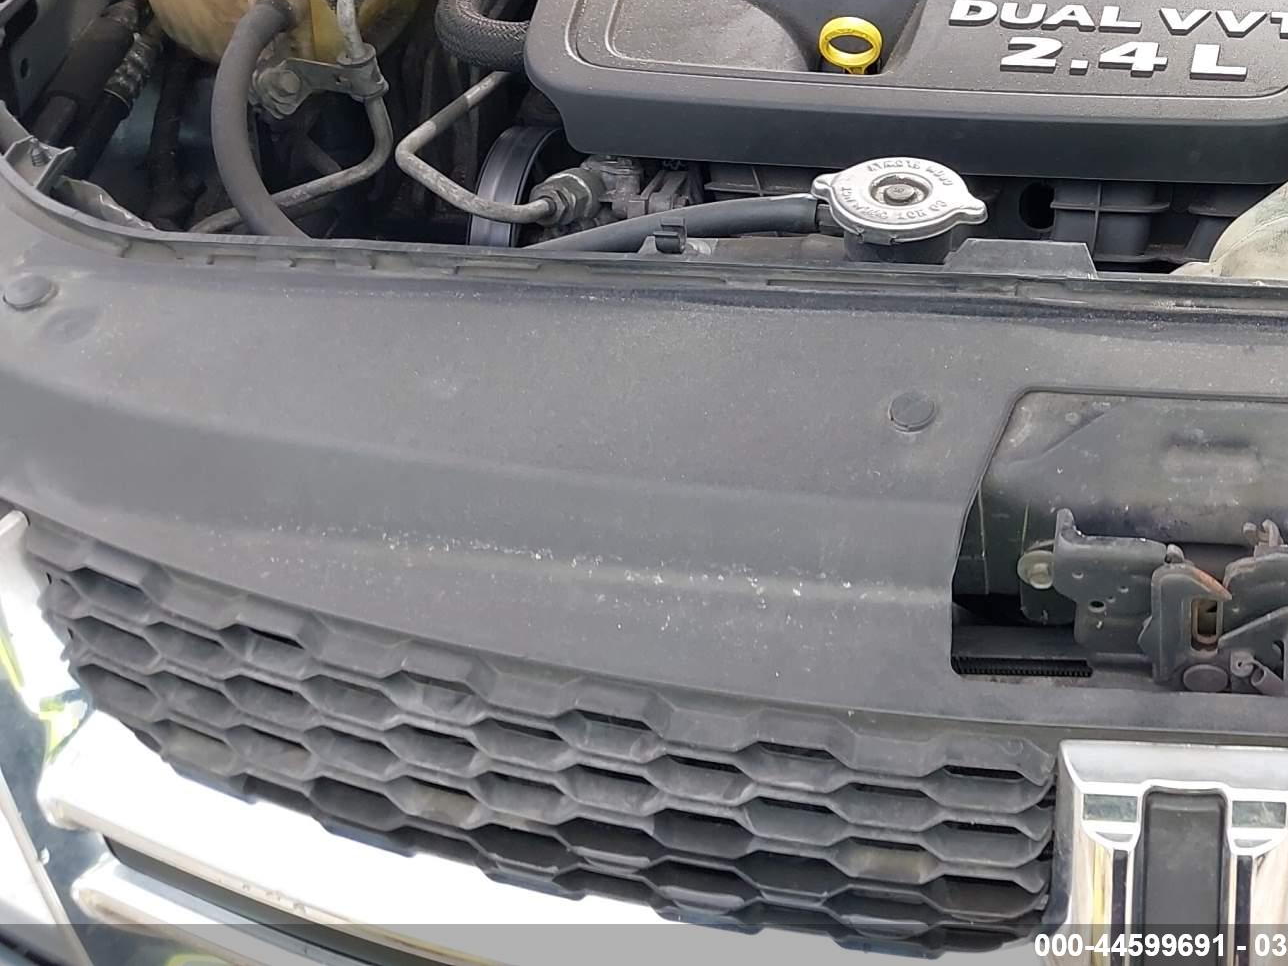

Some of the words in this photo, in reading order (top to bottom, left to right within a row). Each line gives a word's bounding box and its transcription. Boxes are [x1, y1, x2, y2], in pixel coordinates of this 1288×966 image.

[949, 0, 1142, 33] DUAL
[999, 36, 1168, 77] 2.4
[1189, 43, 1248, 81] L
